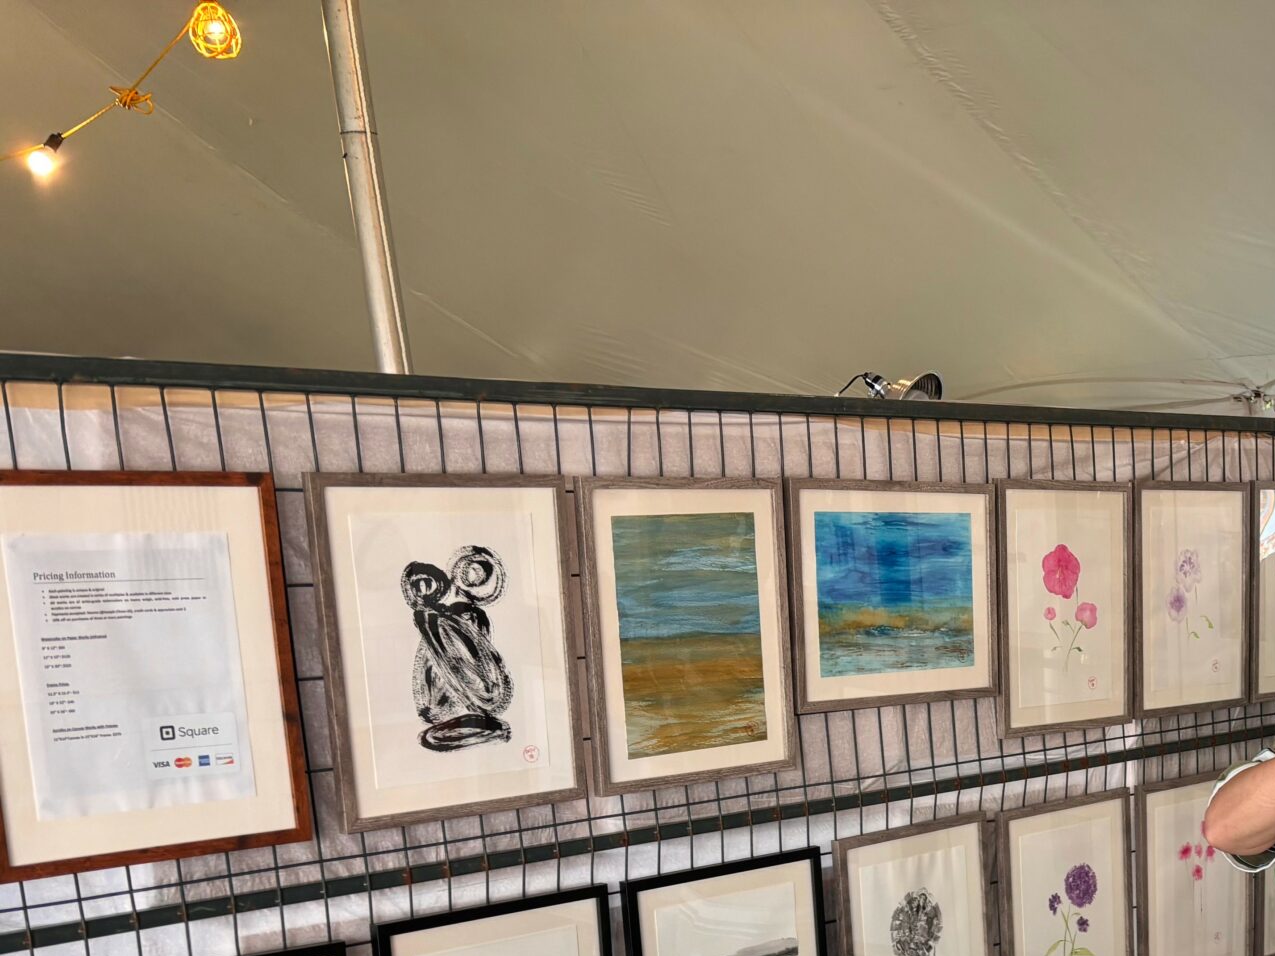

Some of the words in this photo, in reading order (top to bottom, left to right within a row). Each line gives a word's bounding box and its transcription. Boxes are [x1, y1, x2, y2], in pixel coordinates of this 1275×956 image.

[33, 572, 64, 582] Pricing
[65, 571, 116, 580] Information
[178, 726, 220, 739] Square
[152, 761, 171, 769] VISA
